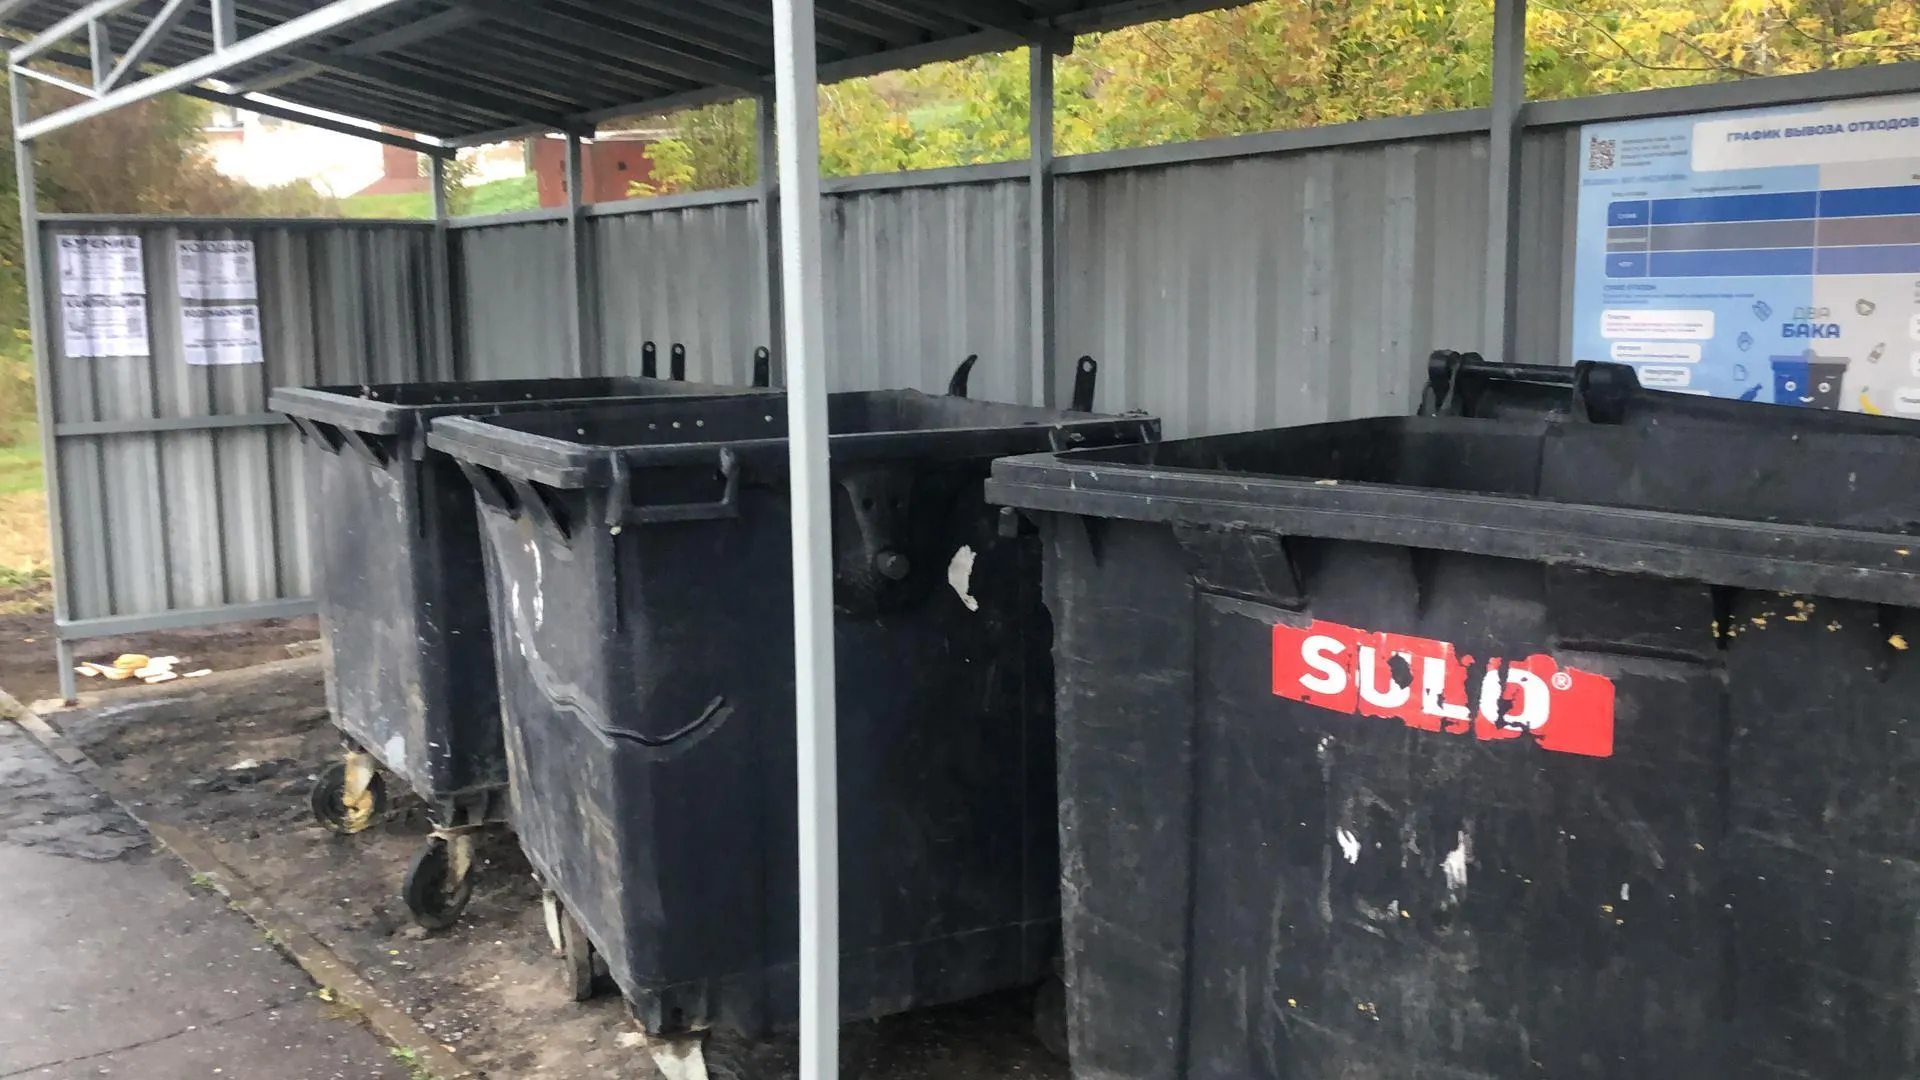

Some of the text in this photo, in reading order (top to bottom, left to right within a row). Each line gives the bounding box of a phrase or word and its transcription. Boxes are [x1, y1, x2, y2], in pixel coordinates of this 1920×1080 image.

[1727, 117, 1919, 142] ГРАФИК ВЫВОЗА ОТХОДОВ
[1792, 306, 1831, 319] ДВА
[1782, 323, 1840, 338] БАКА
